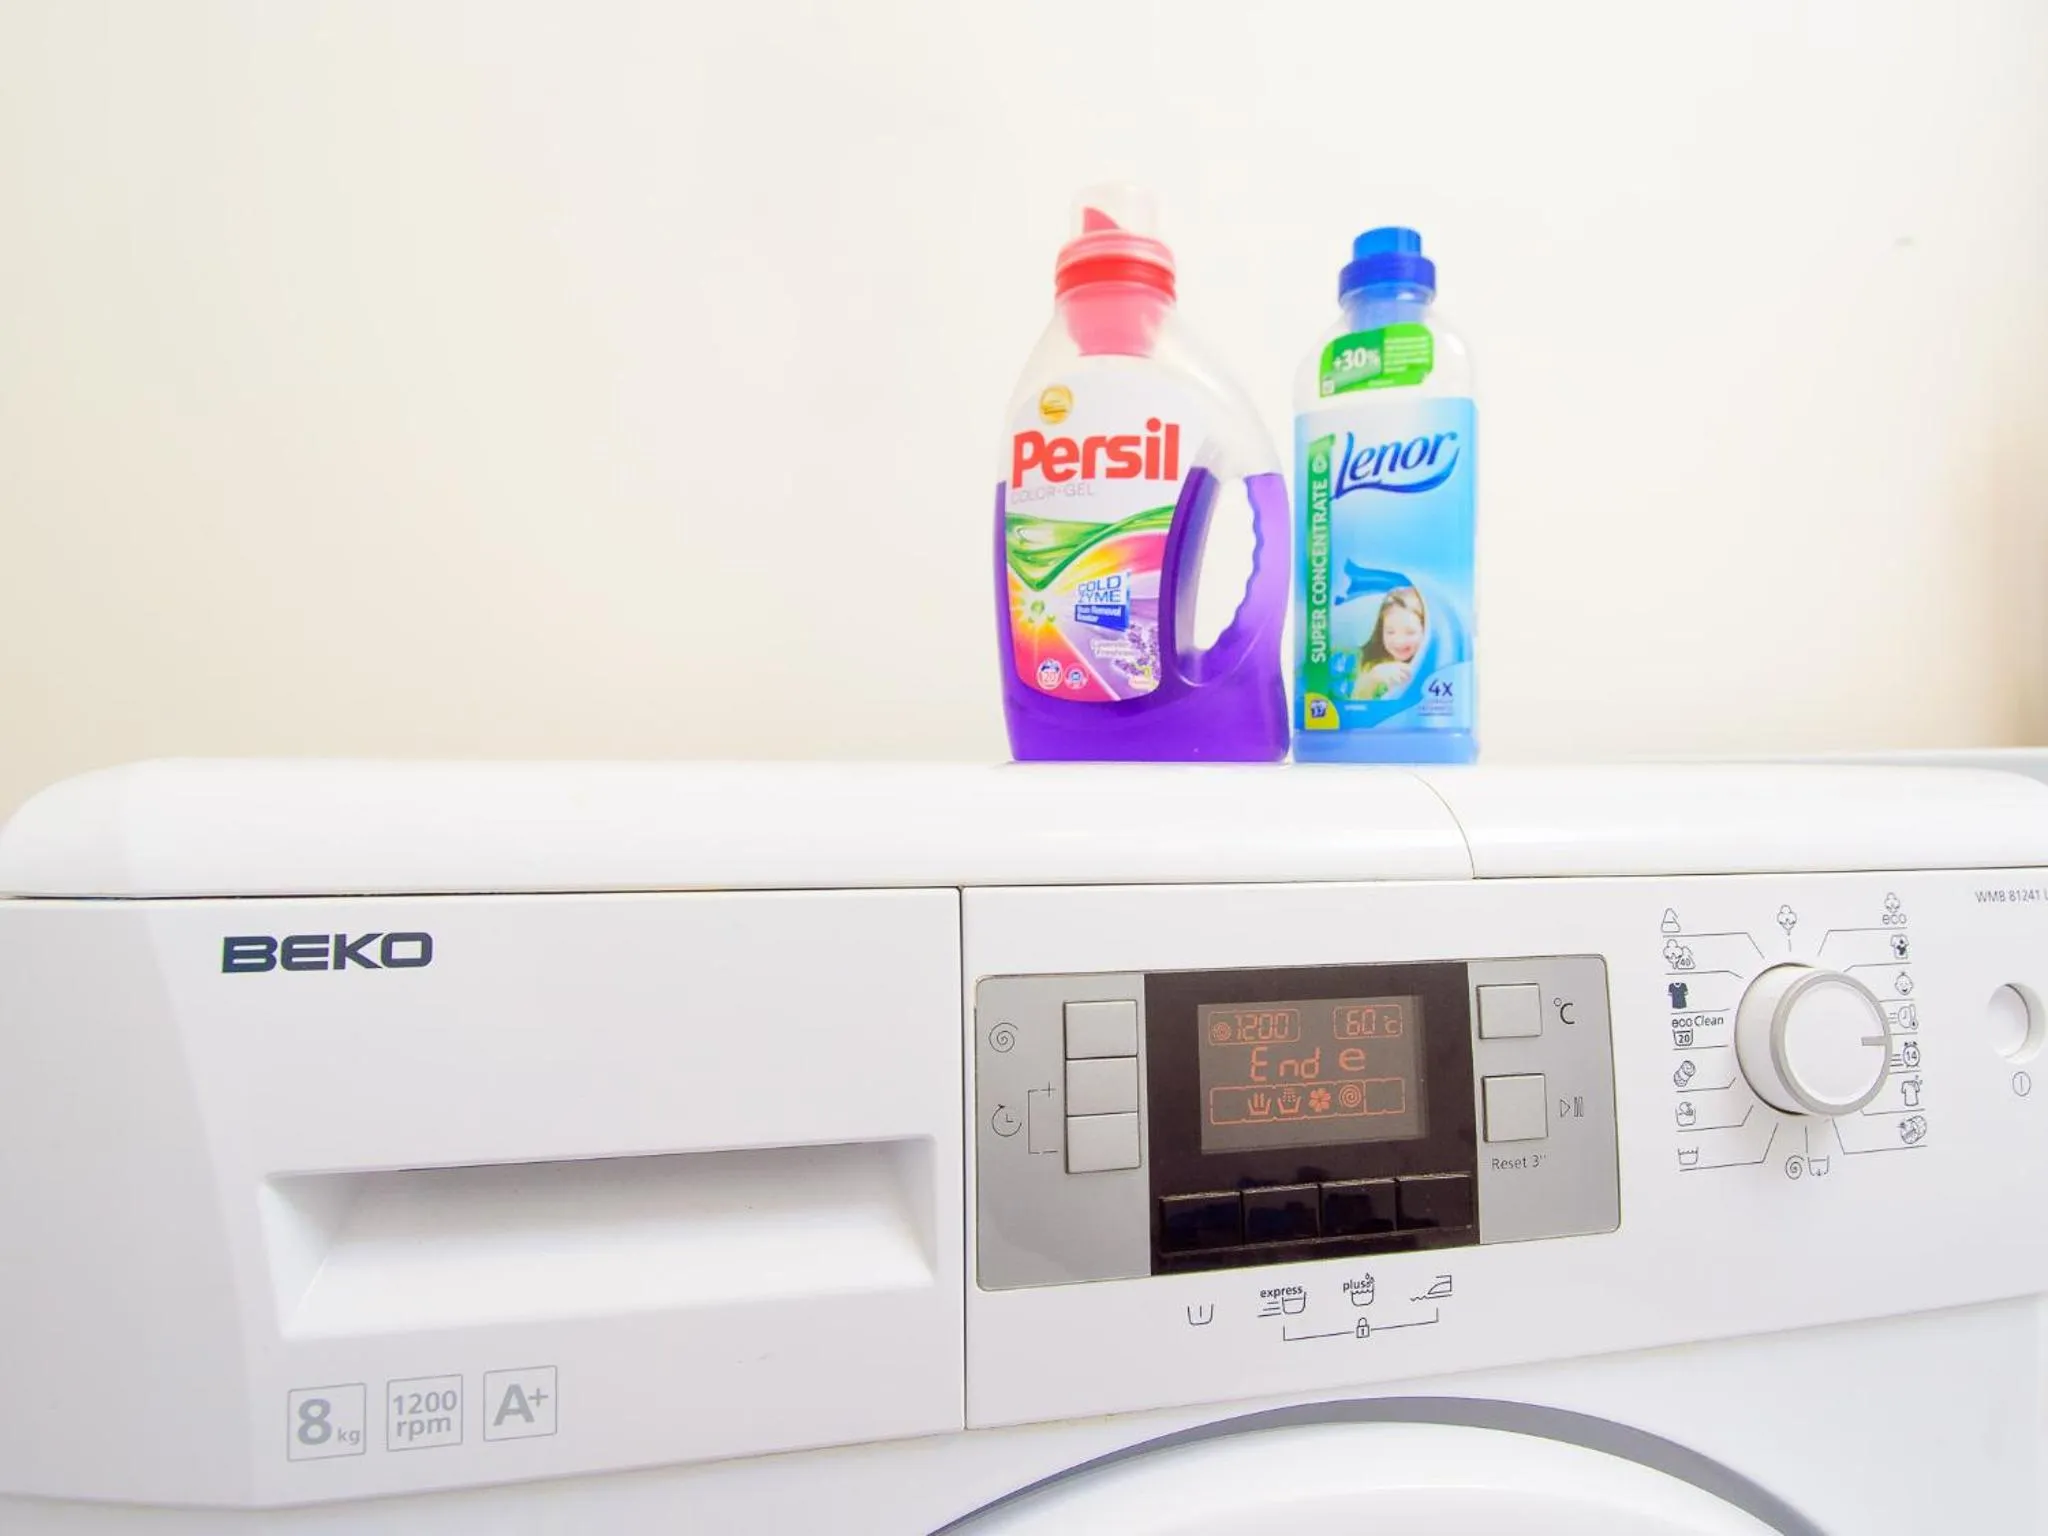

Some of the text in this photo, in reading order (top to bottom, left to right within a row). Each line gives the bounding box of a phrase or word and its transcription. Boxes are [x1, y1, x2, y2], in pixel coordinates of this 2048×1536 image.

[1012, 417, 1180, 490] Persil
[1332, 431, 1460, 499] Lenor
[1078, 575, 1121, 592] COLD
[1311, 479, 1328, 663] SUPER CONCENTRATE
[1882, 913, 1907, 925] eco
[222, 932, 433, 973] BEKO
[1235, 1013, 1289, 1041] 1200
[1491, 1157, 1527, 1170] Reset
[1260, 1285, 1304, 1299] express
[393, 1389, 458, 1417] 1200
[493, 1383, 549, 1427] A+
[297, 1398, 361, 1446] 8 kg
[396, 1416, 452, 1441] rpm
